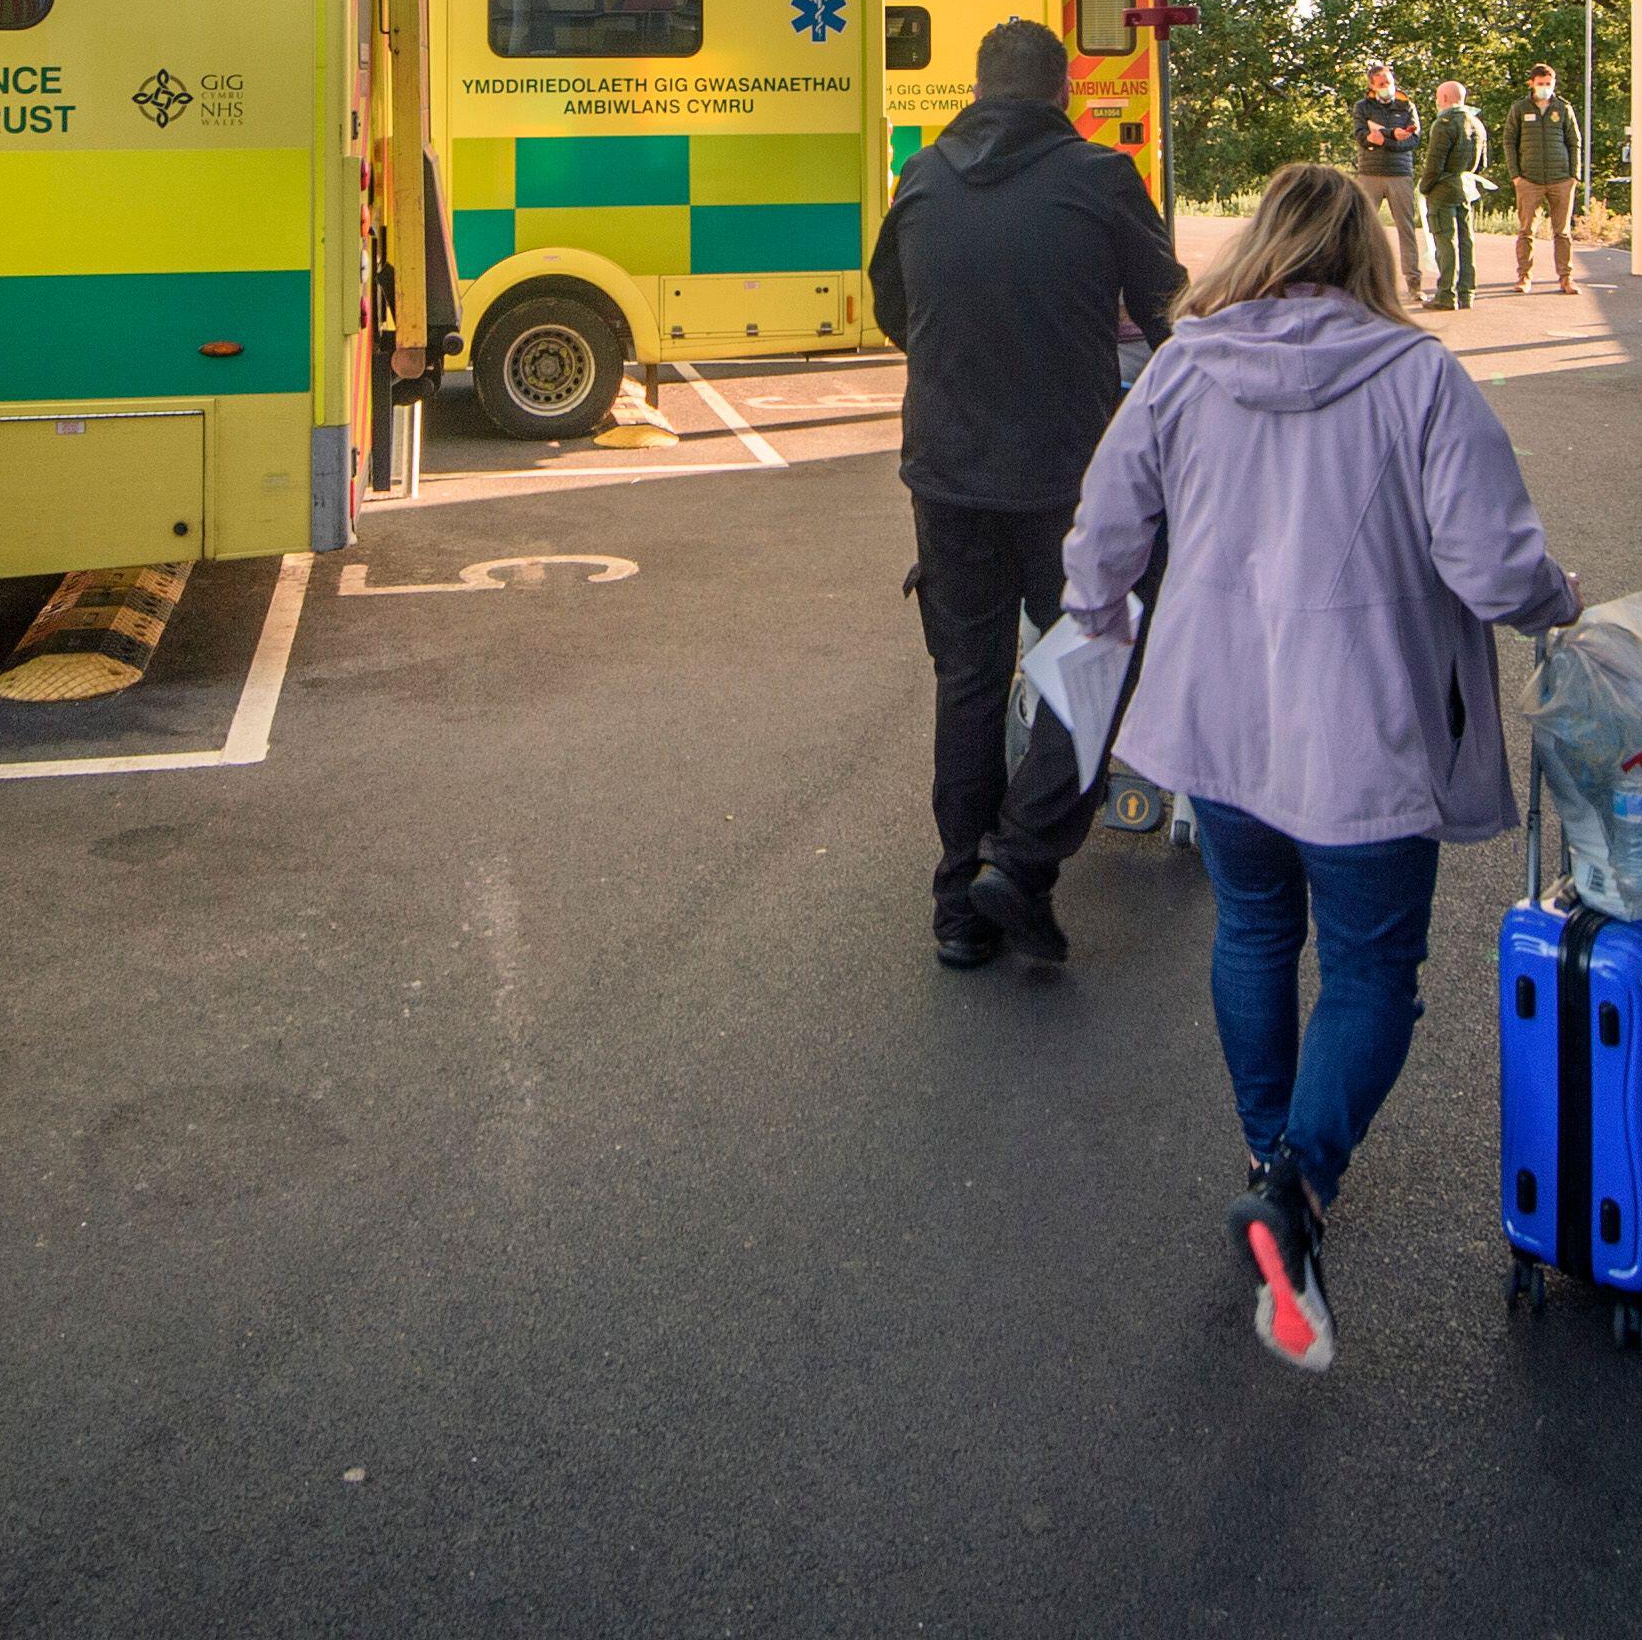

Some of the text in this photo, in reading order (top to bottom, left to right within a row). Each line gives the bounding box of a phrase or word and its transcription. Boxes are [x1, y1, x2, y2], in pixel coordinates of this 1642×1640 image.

[200, 74, 244, 91] GIG
[462, 76, 851, 94] YMDDIRIEDOLAETH GIG GWASANAETHAU
[897, 84, 921, 95] GIG
[1068, 81, 1148, 96] AMBIWLANS
[200, 91, 244, 100] CYMRU
[200, 102, 244, 118] NHS
[563, 98, 754, 115] AMBIWLANS CYMRU
[887, 100, 916, 111] ANS
[200, 119, 244, 127] WALES
